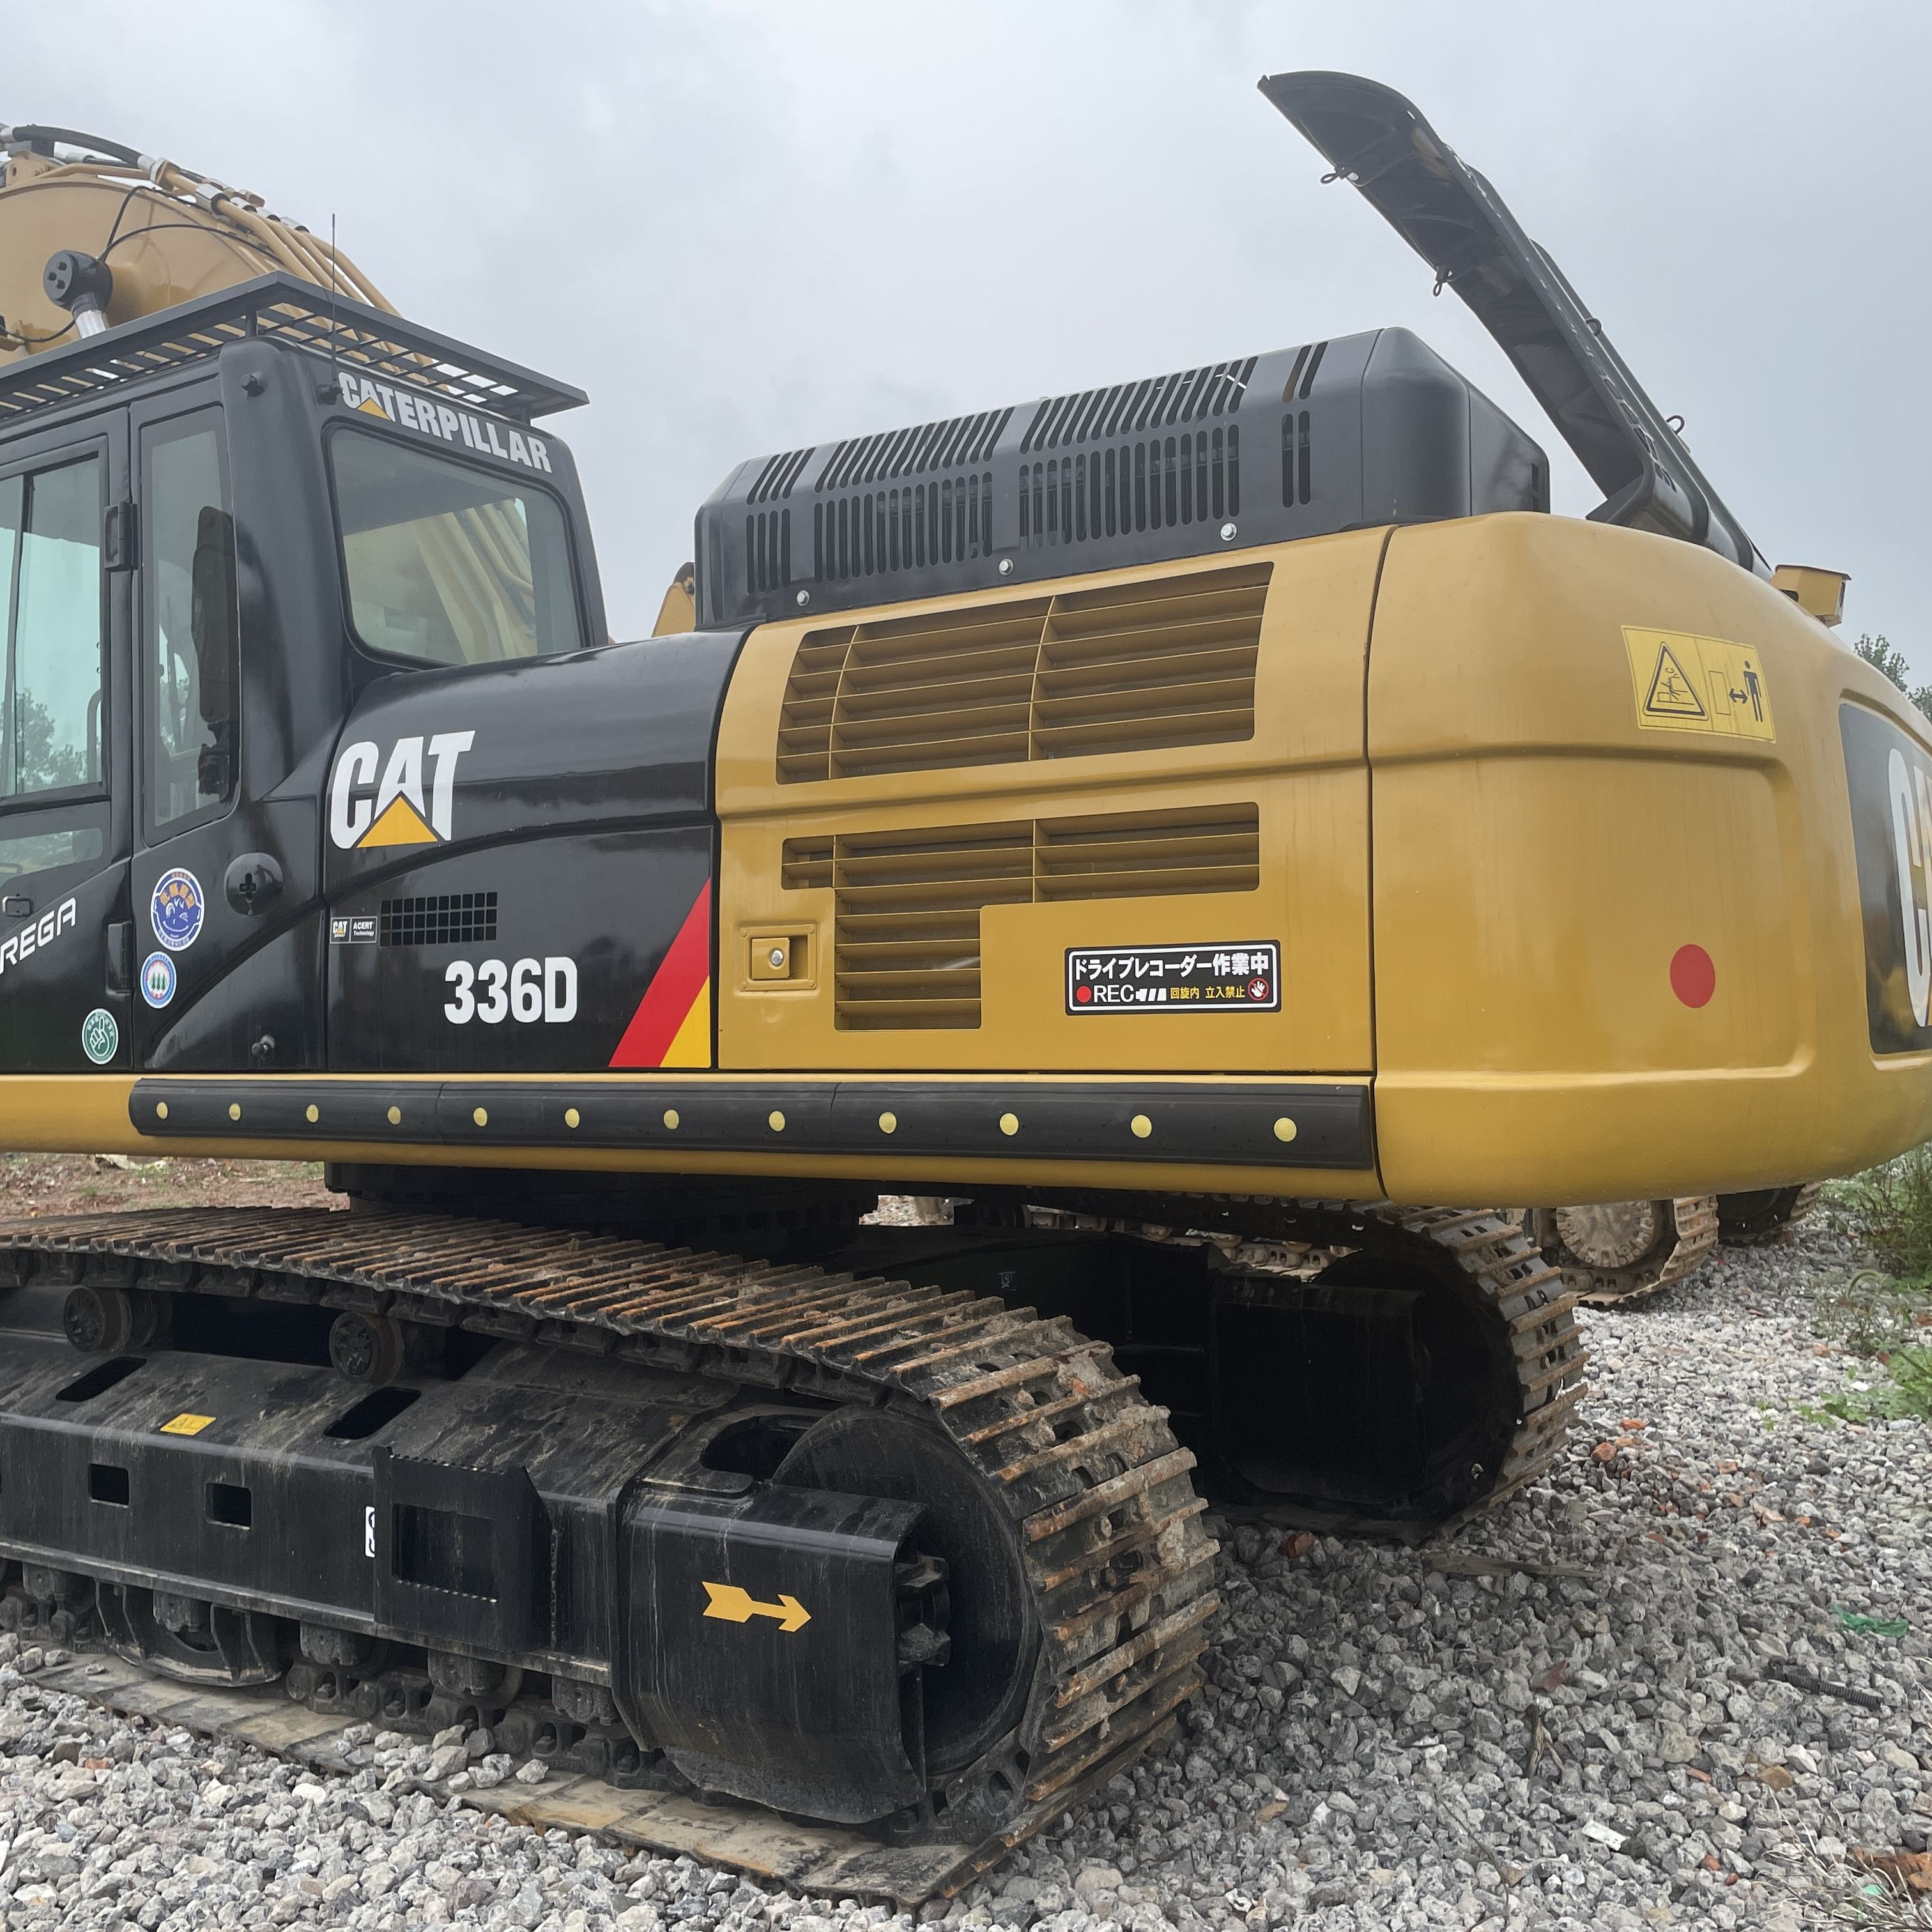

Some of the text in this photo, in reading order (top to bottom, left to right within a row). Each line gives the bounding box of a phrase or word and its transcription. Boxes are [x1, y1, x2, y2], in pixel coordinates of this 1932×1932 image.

[338, 372, 552, 473] CATERPILLAR
[330, 730, 475, 849] CAT
[0, 897, 76, 974] REGA
[333, 921, 348, 934] CAT
[353, 921, 373, 930] ACERT
[444, 956, 578, 1024] 336D
[1076, 951, 1269, 981] ドライブレコーダー作業中
[1094, 985, 1246, 1003] REC 回旋内 立入禁止
